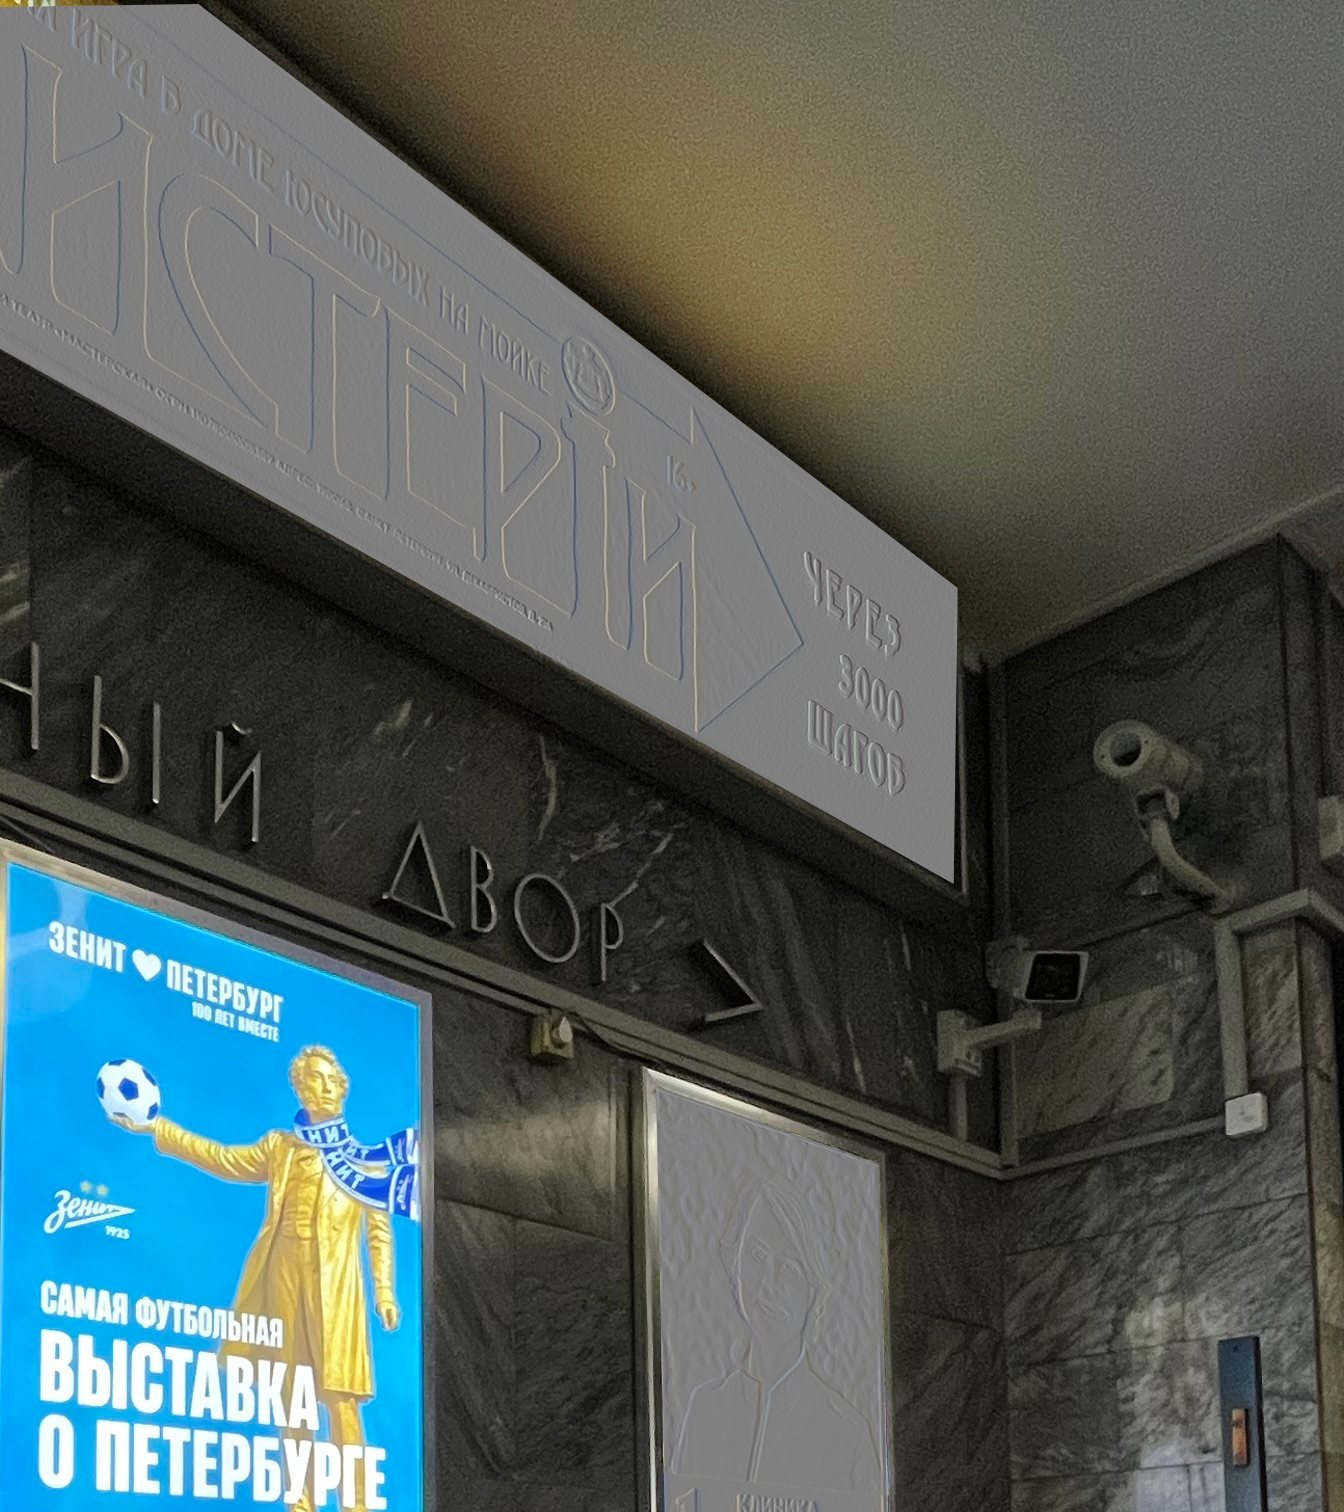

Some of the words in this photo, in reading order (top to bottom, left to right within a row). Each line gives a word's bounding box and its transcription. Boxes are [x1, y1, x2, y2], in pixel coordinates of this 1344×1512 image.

[381, 820, 624, 983] ДВОР
[49, 921, 126, 973] ЗЕНИТ
[166, 959, 284, 1023] ПЕТЕРБУРГ
[192, 1002, 212, 1021] 100
[214, 1008, 235, 1028] ЛЕТ
[238, 1016, 280, 1042] ВМЕСТЕ
[105, 1225, 130, 1240] 1925
[40, 1280, 129, 1326] САМАЯ
[135, 1296, 284, 1349] ФУТБОЛЬНАЯ
[39, 1328, 320, 1431] ВЫСТАВКА
[38, 1413, 75, 1489] О
[95, 1419, 388, 1510] ПЕТЕРБУРГЕ
